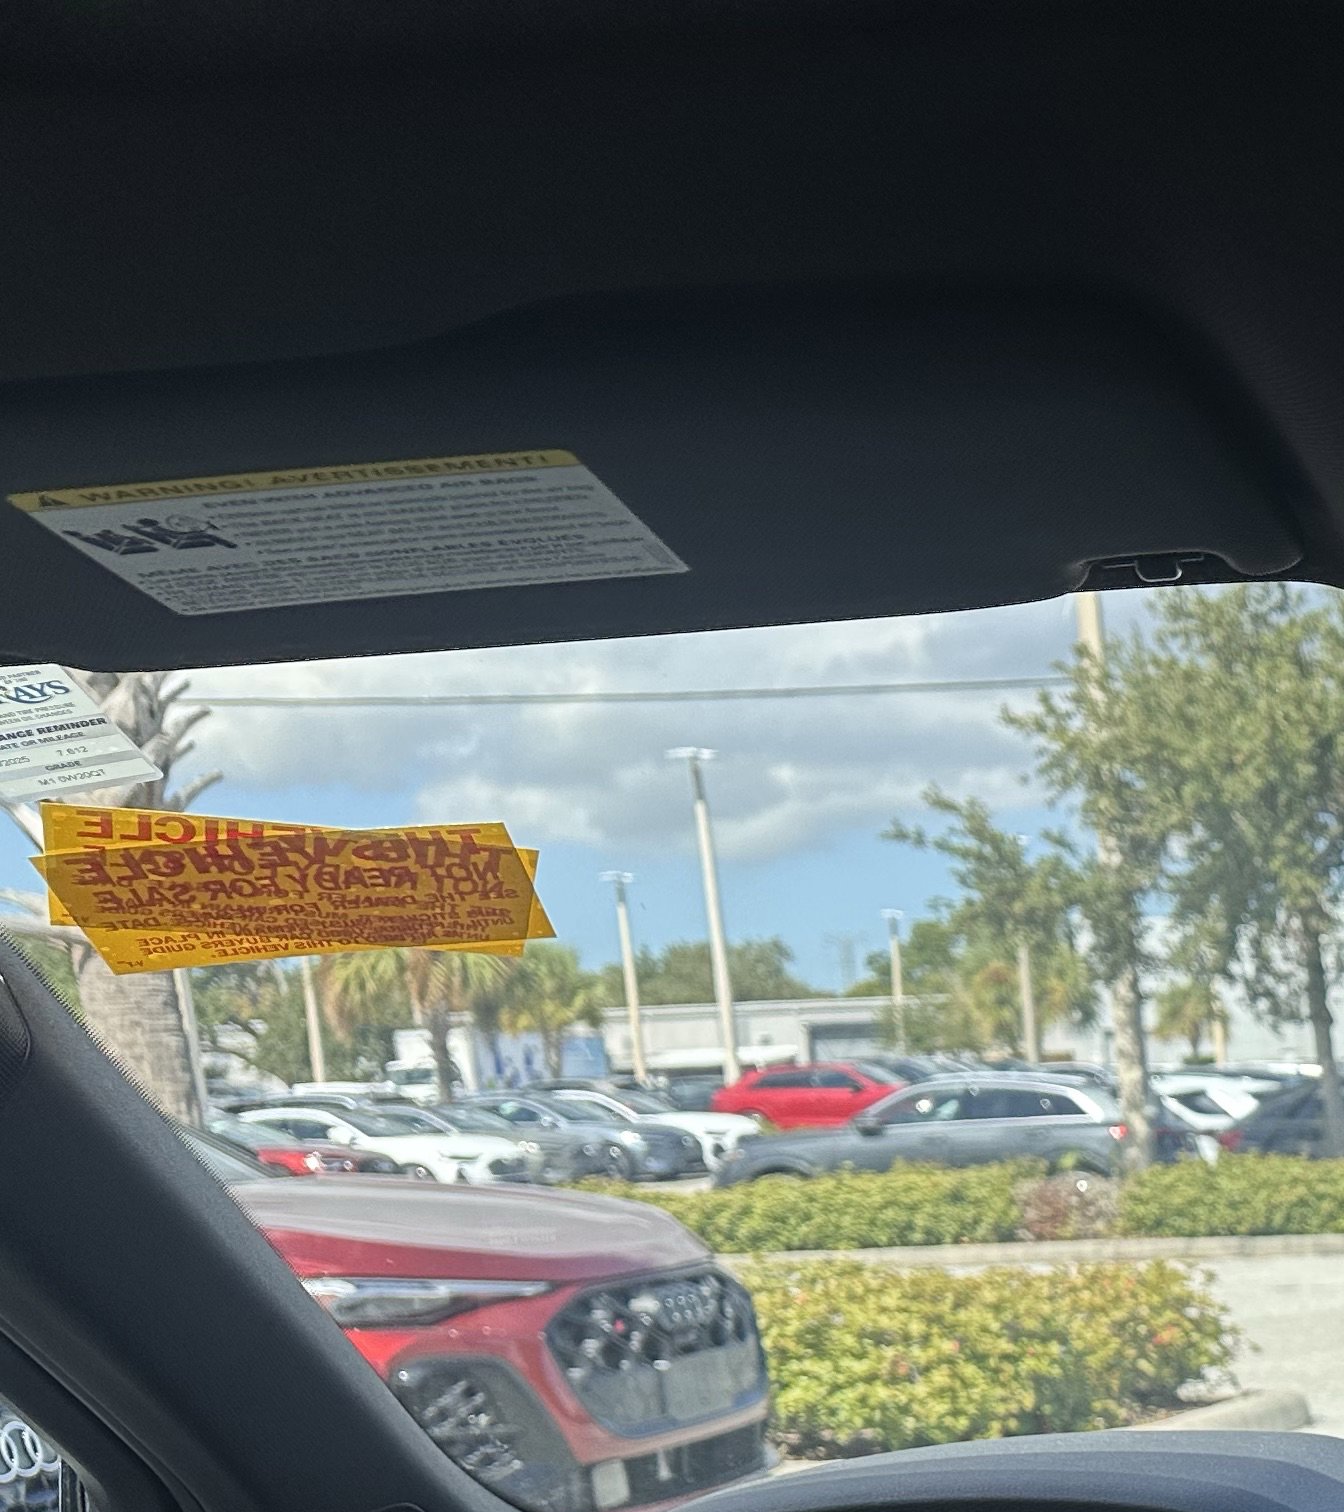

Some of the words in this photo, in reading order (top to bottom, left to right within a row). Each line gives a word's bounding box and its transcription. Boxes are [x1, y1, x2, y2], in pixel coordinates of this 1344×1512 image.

[79, 478, 257, 502] WARNING!
[270, 455, 548, 486] AVERTISSEMENT!
[36, 717, 108, 735] REMINDER
